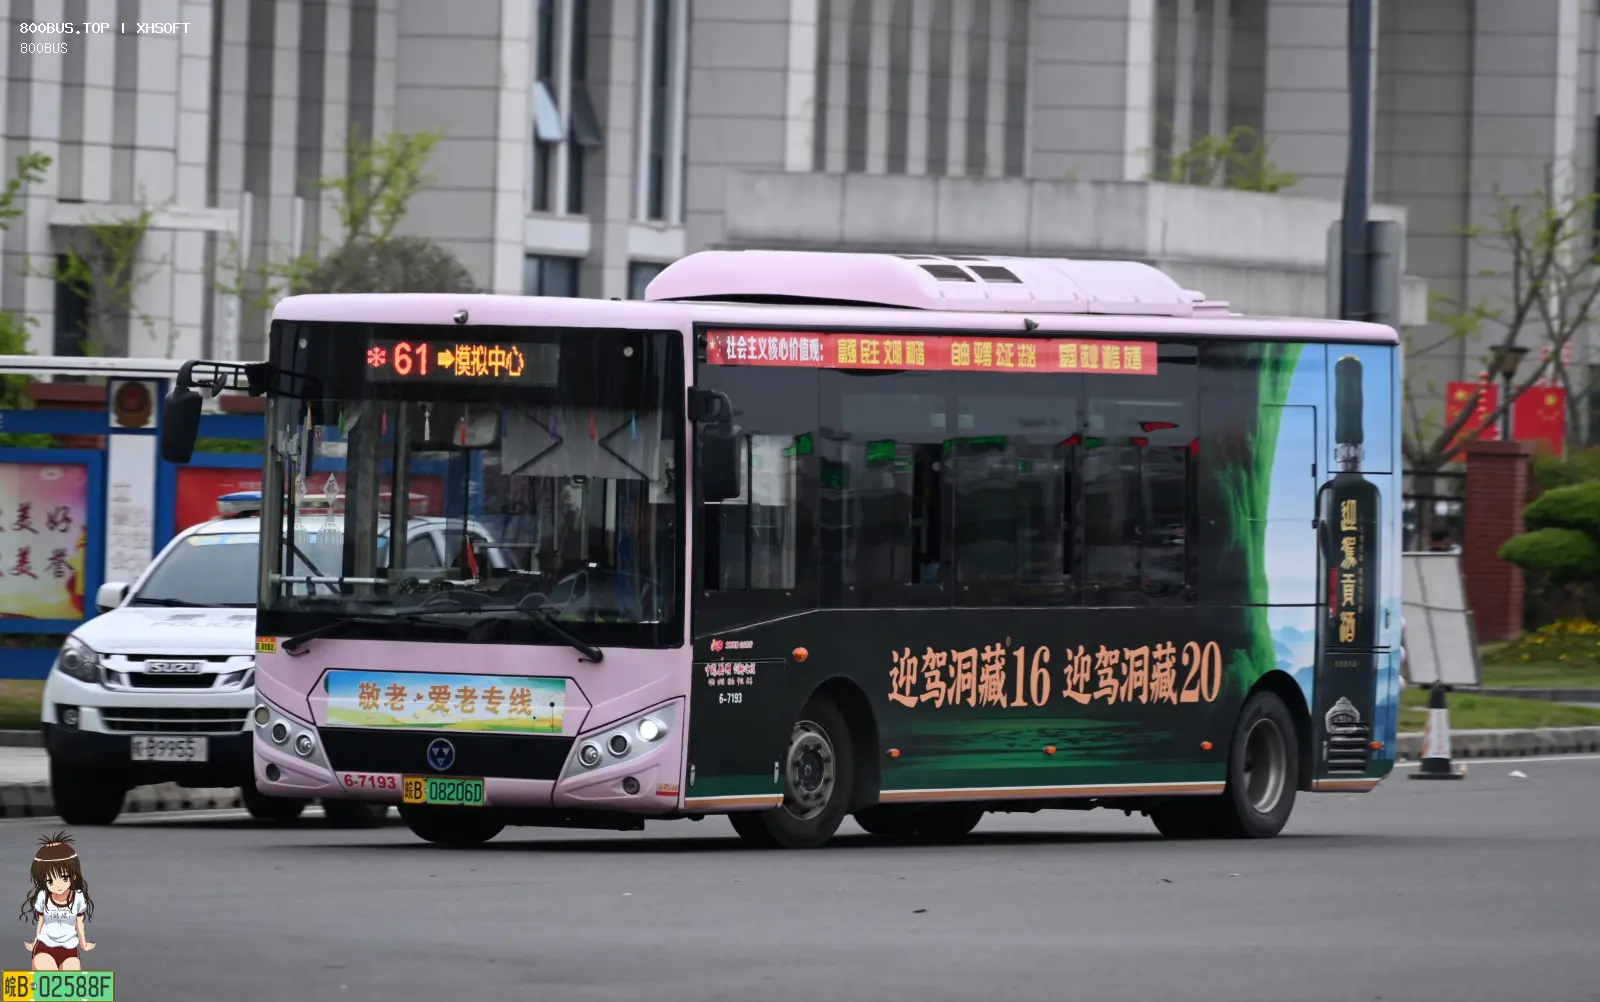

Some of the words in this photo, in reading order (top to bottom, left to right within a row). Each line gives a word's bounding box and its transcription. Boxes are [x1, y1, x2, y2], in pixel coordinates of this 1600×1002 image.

[394, 342, 428, 376] 61
[455, 344, 525, 377] 模拟中心
[149, 662, 198, 673] ISUZU
[718, 692, 743, 704] 6-7193
[343, 774, 396, 790] 6-7193
